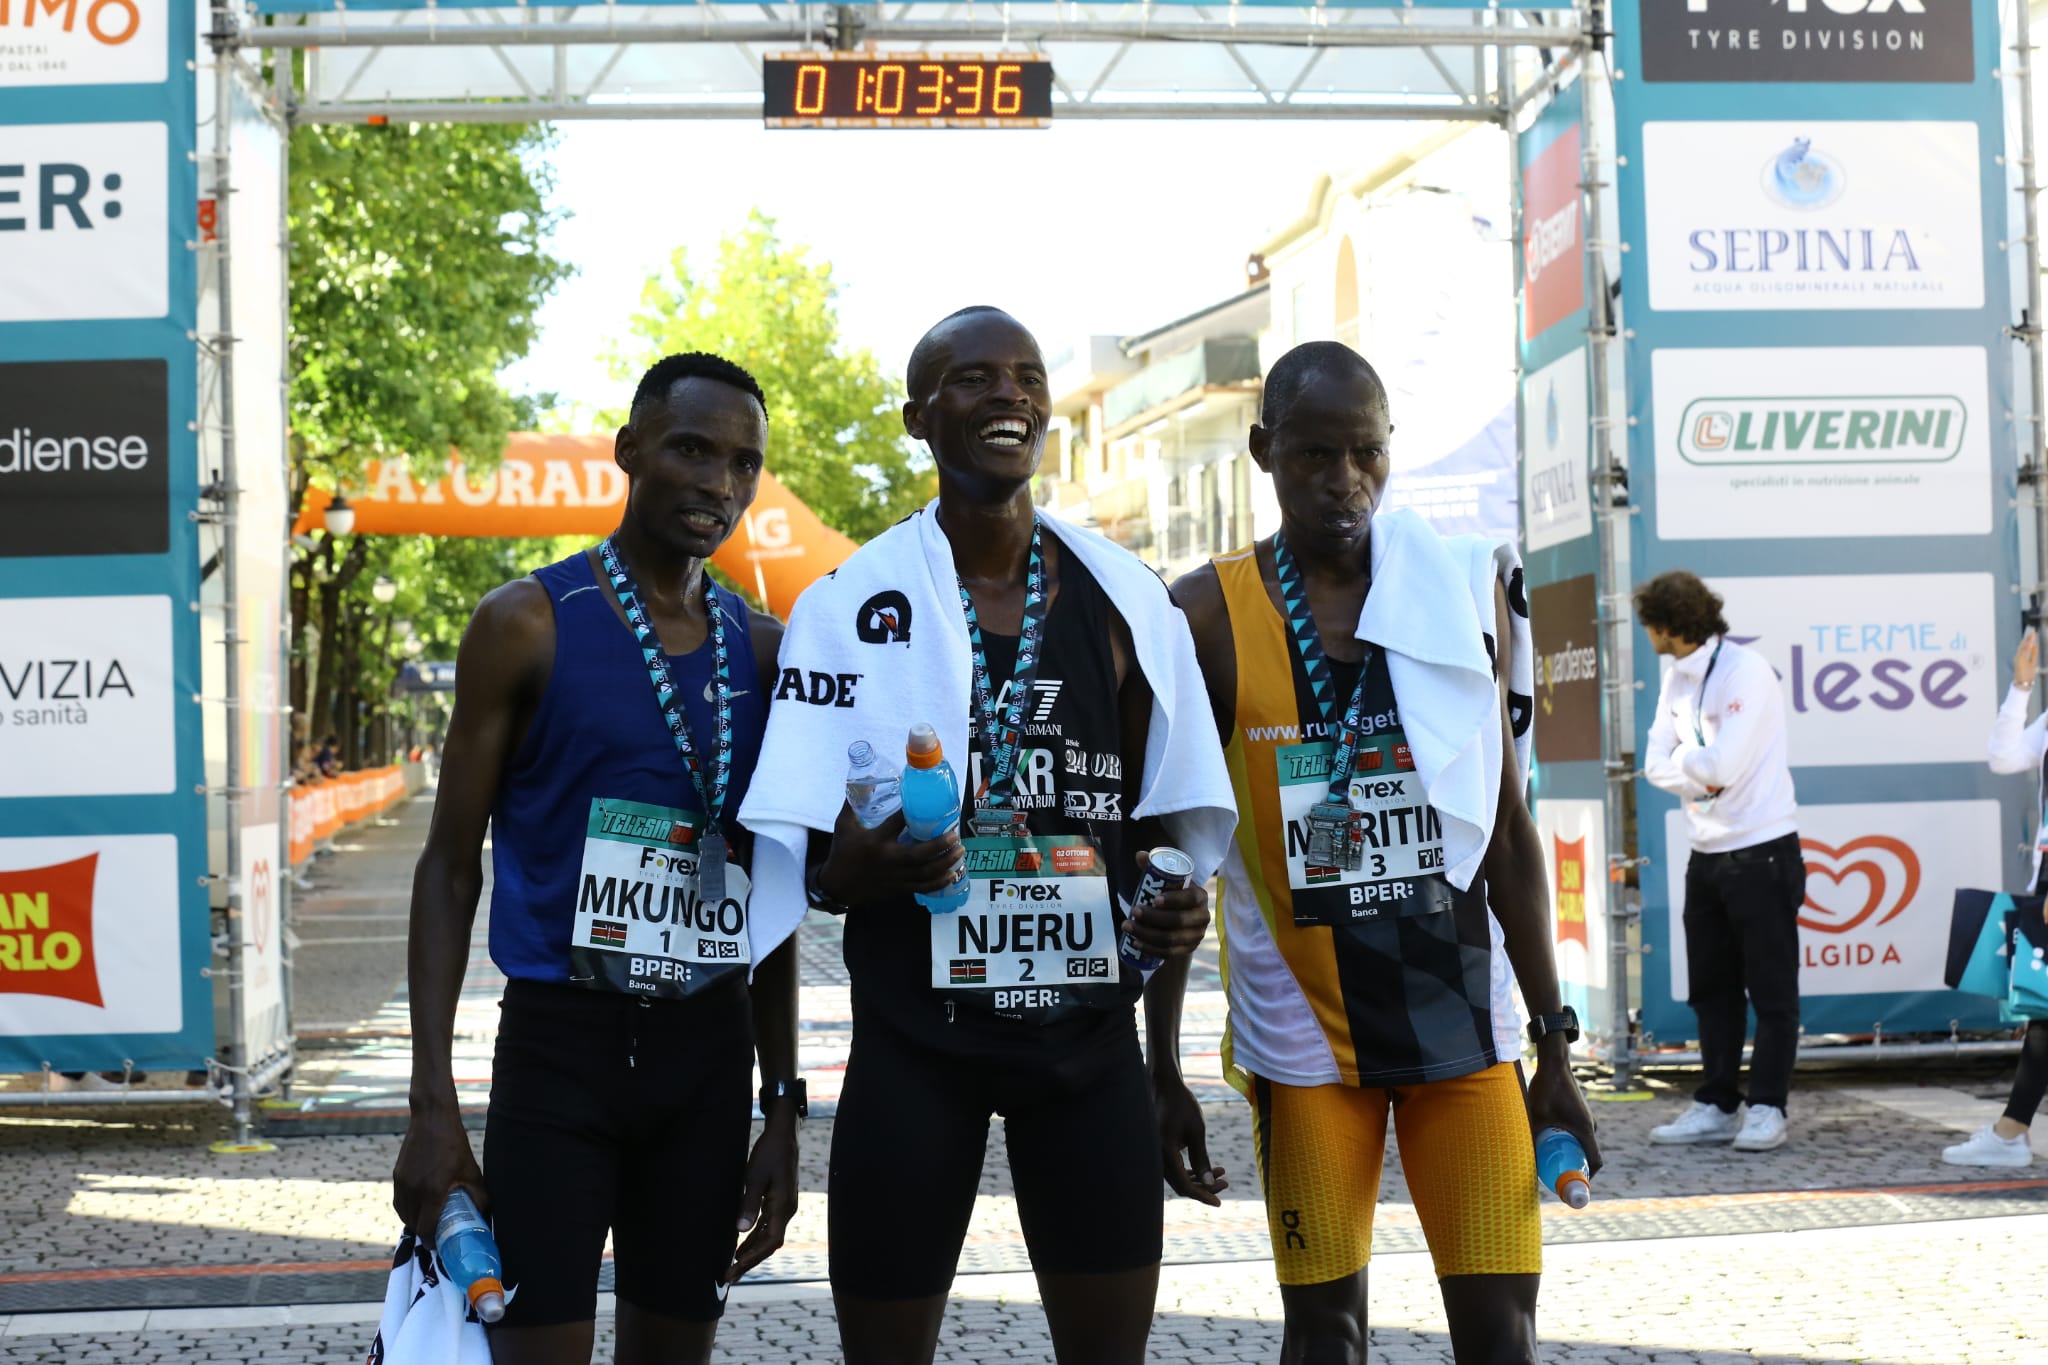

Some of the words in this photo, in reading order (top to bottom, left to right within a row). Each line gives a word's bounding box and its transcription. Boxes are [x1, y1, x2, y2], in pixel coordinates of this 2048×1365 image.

[1688, 29, 1760, 50] TYRE
[1782, 28, 1925, 50] DIVISION
[1688, 228, 1922, 272] SEPINIA
[1693, 281, 1740, 294] ACQUA
[1873, 279, 1945, 292] NATURALE
[1732, 410, 1953, 452] LIVERINI
[0, 428, 149, 472] diense
[342, 458, 627, 508] ATORAD
[1809, 623, 1942, 653] TERME
[1949, 631, 1967, 651] di
[0, 659, 135, 701] VIZIA
[775, 667, 857, 708] ADE
[1774, 644, 1969, 714] lese
[13, 701, 88, 727] sanità
[1090, 753, 1122, 781] OR
[1290, 753, 1333, 779] TELE
[1036, 795, 1056, 809] RUN
[600, 810, 673, 842] TELESIA
[1288, 803, 1443, 858] MRITI
[1370, 853, 1387, 877] 3
[989, 879, 1062, 902] Forex
[1349, 881, 1415, 905] BPER:
[579, 873, 744, 936] MKUNGO
[1351, 908, 1378, 918] Banca
[659, 930, 671, 954] 1
[958, 912, 1094, 955] NJERU
[1799, 943, 1901, 968] LGIDA
[629, 957, 692, 983] BPER:
[1018, 958, 1035, 982] 2
[628, 979, 656, 991] Banca
[994, 989, 1060, 1009] BPER:
